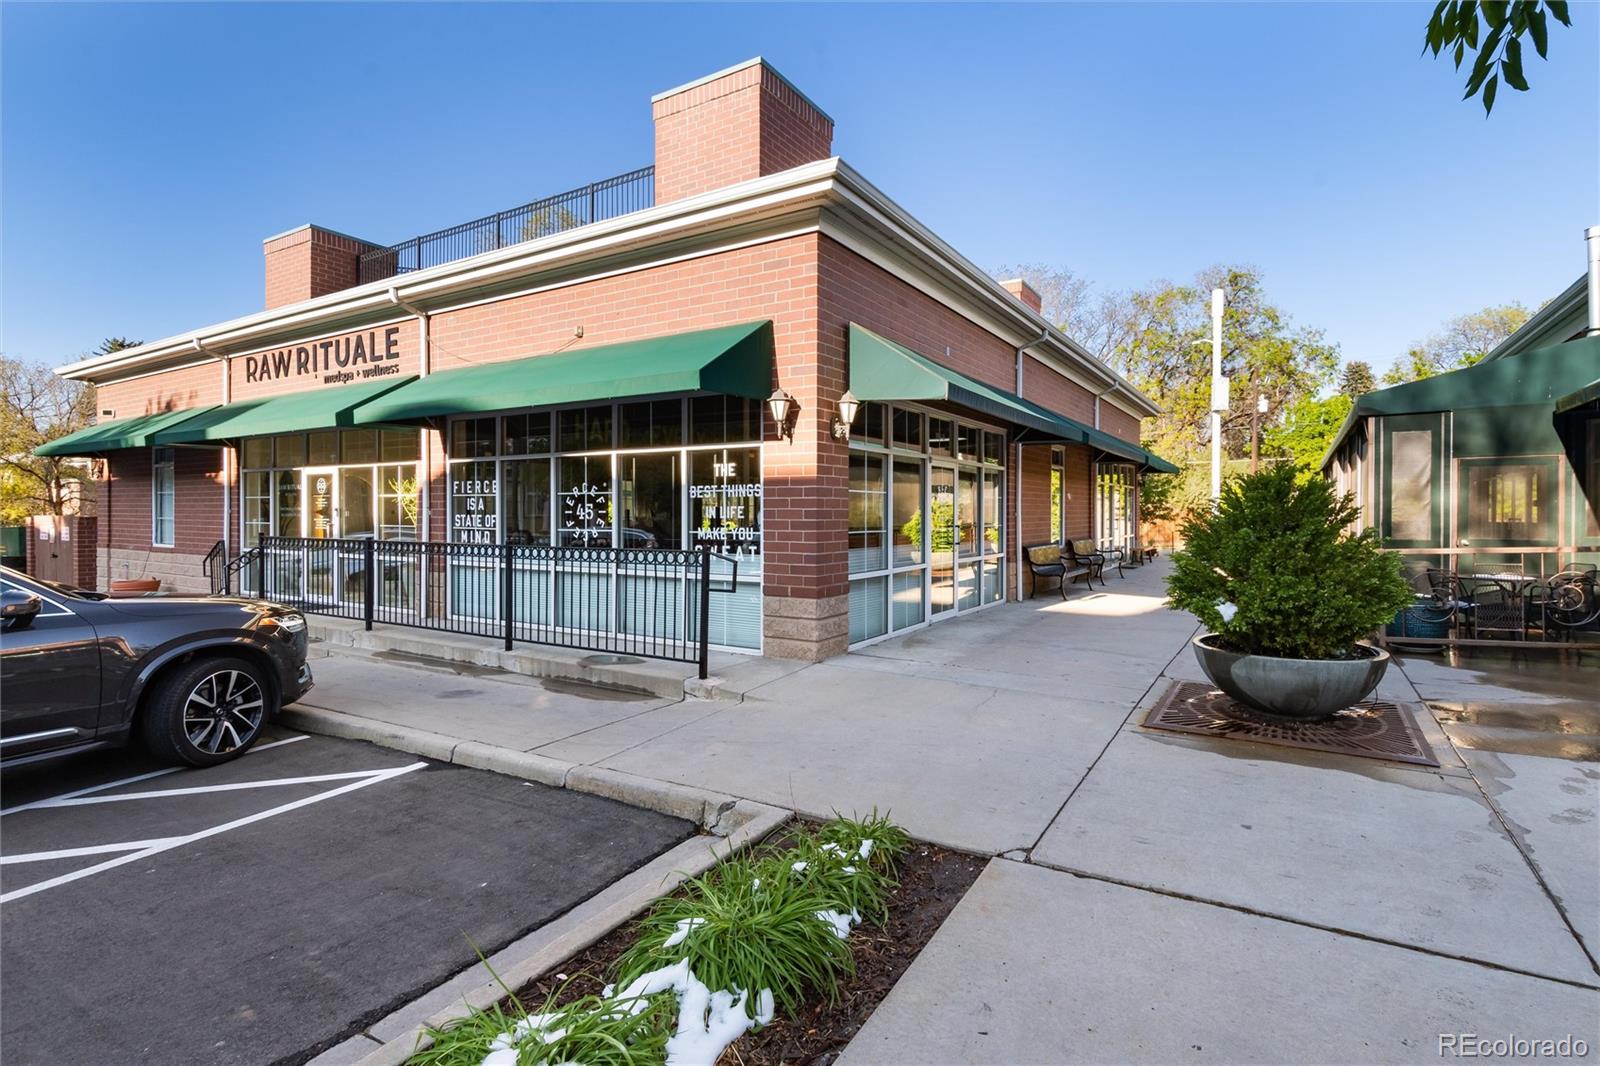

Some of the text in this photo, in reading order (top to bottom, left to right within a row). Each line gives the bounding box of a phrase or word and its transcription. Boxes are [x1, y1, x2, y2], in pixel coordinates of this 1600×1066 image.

[246, 327, 399, 383] RAW RITUALE
[324, 369, 354, 384] medspa
[362, 364, 399, 379] wellness
[713, 462, 736, 476] THE
[453, 480, 497, 493] FIERCE
[690, 484, 761, 498] BEST THINGS
[467, 497, 485, 510] IS A
[576, 503, 594, 520] 45
[705, 506, 745, 518] IN LIFE
[455, 514, 497, 527] STATE OF
[461, 530, 490, 544] MIND
[697, 527, 754, 540] MAKE YOU
